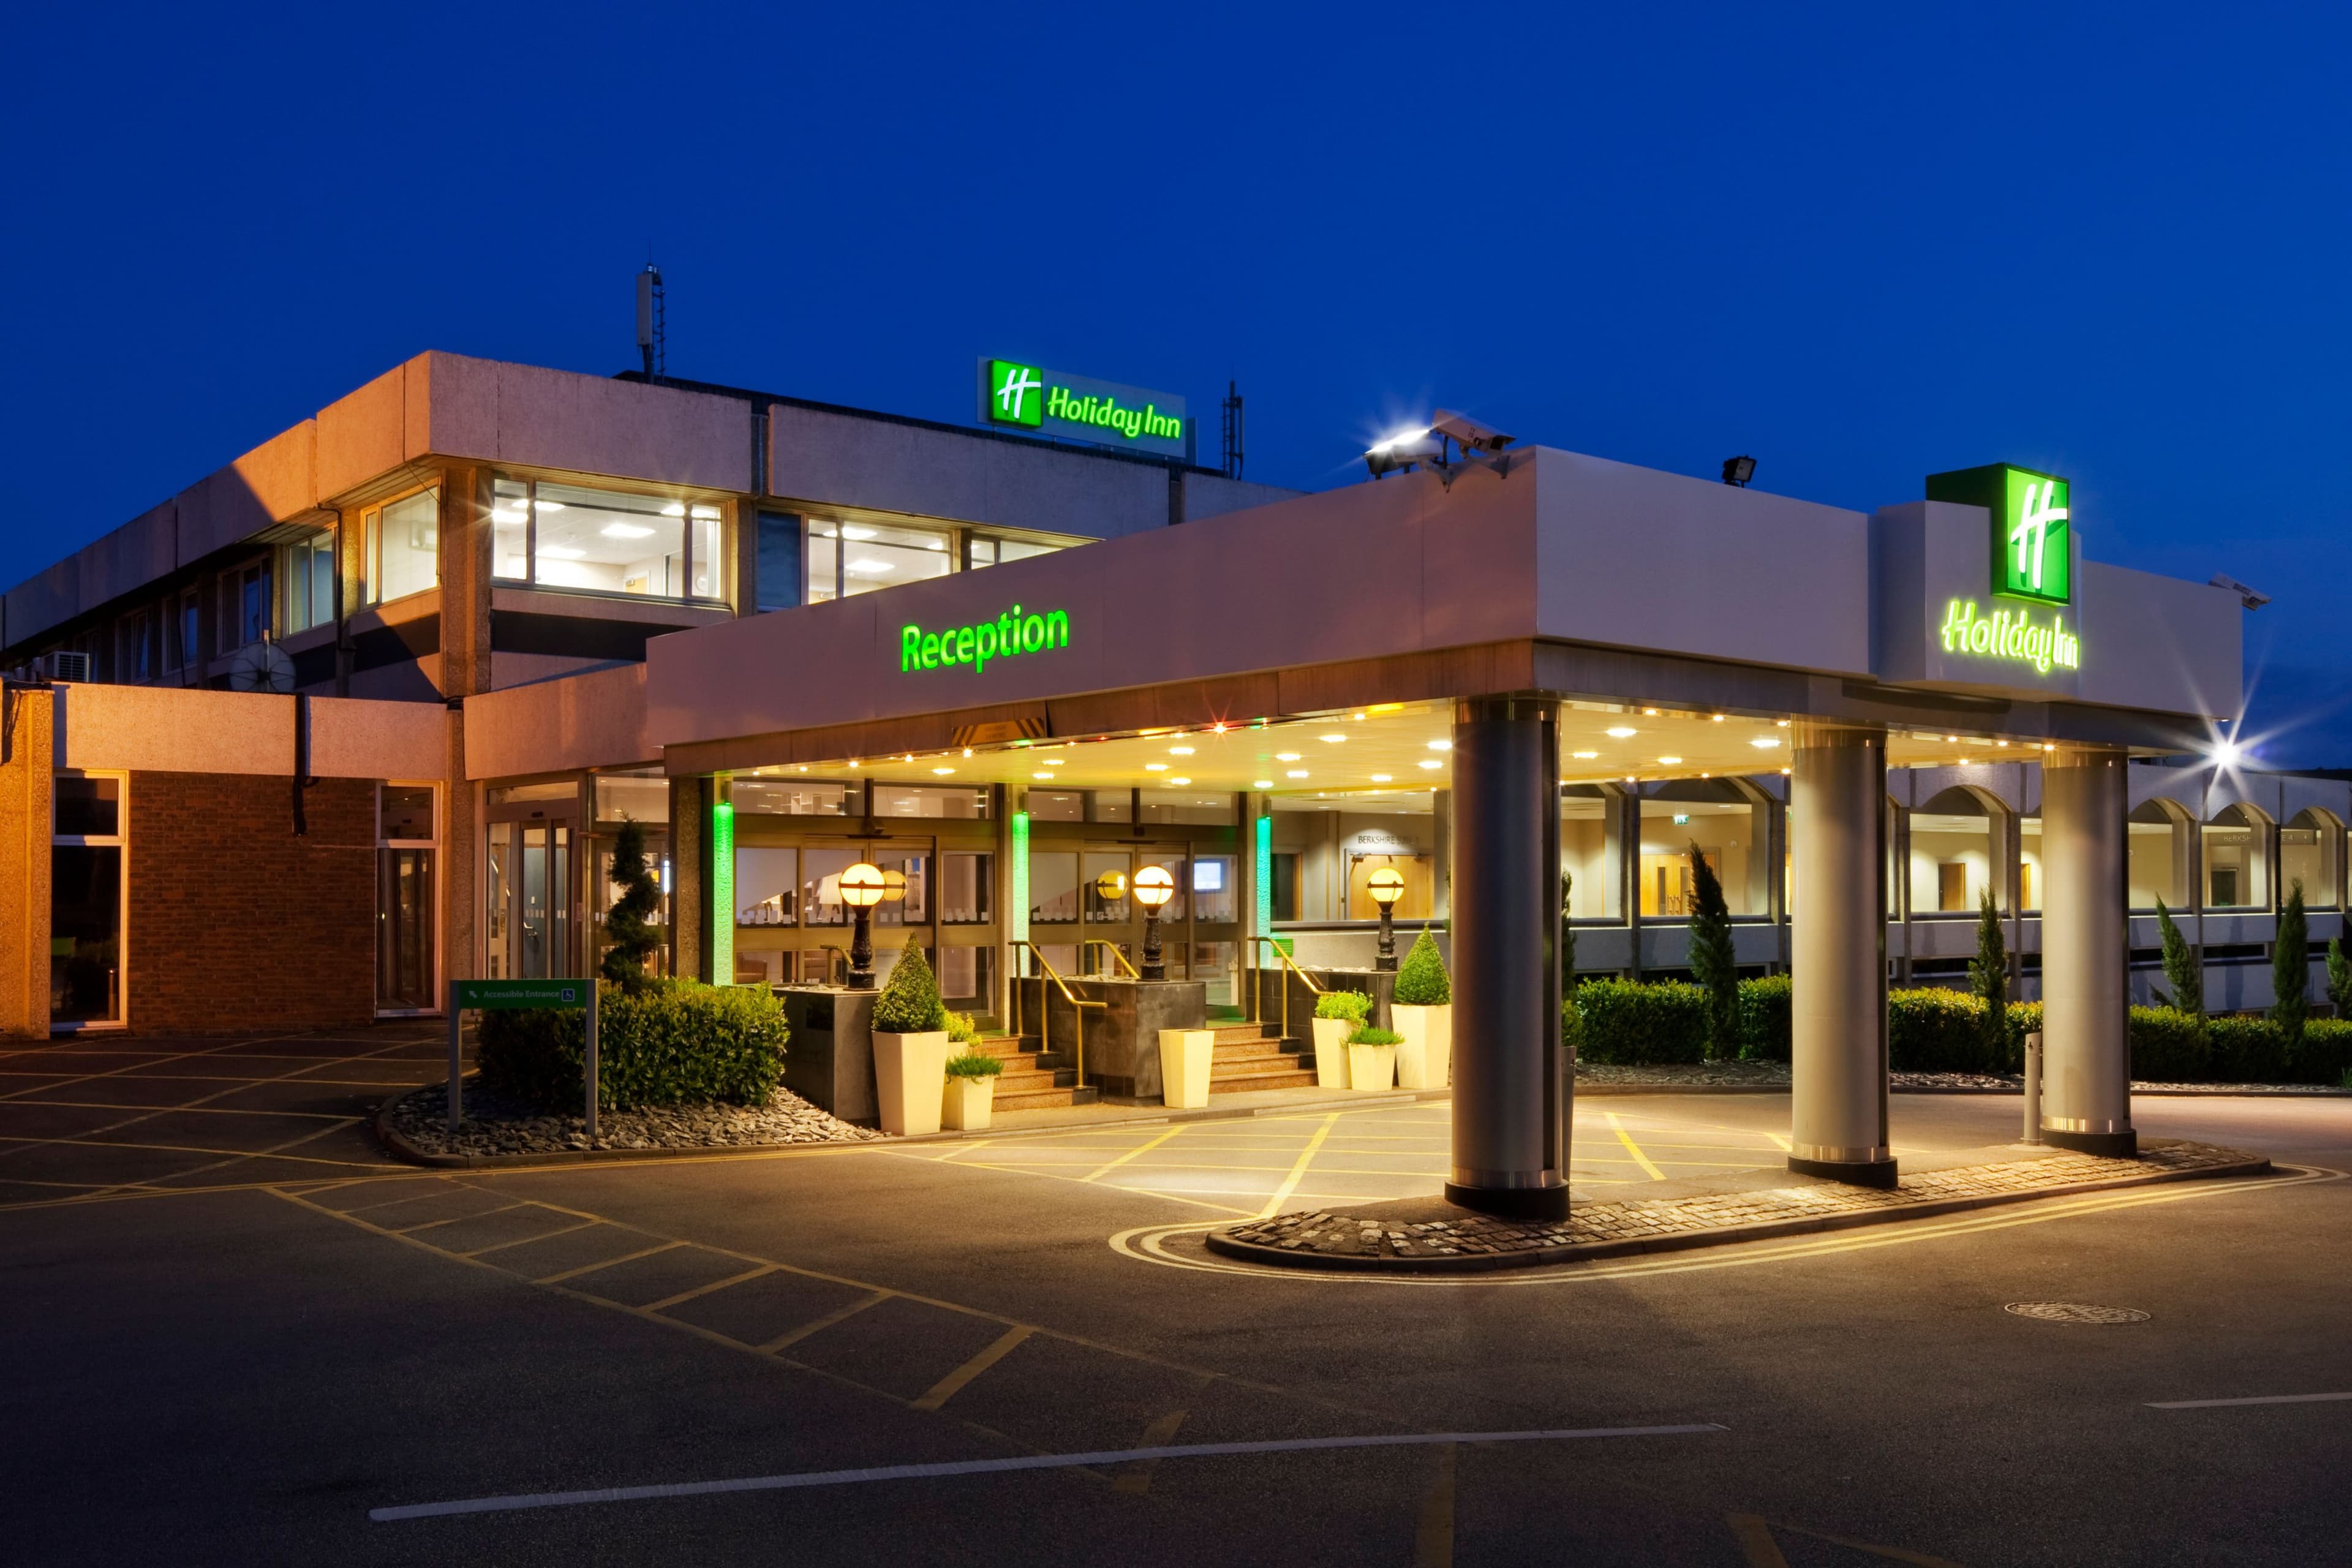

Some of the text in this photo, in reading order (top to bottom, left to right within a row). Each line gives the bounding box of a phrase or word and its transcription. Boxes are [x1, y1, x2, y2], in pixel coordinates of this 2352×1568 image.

[1047, 386, 1181, 439] Holiday Inn
[902, 604, 1068, 674] Reception
[1941, 600, 2078, 673] Holiday Inn
[1358, 835, 1395, 844] BERKSHIRE
[483, 990, 524, 998] Accessible
